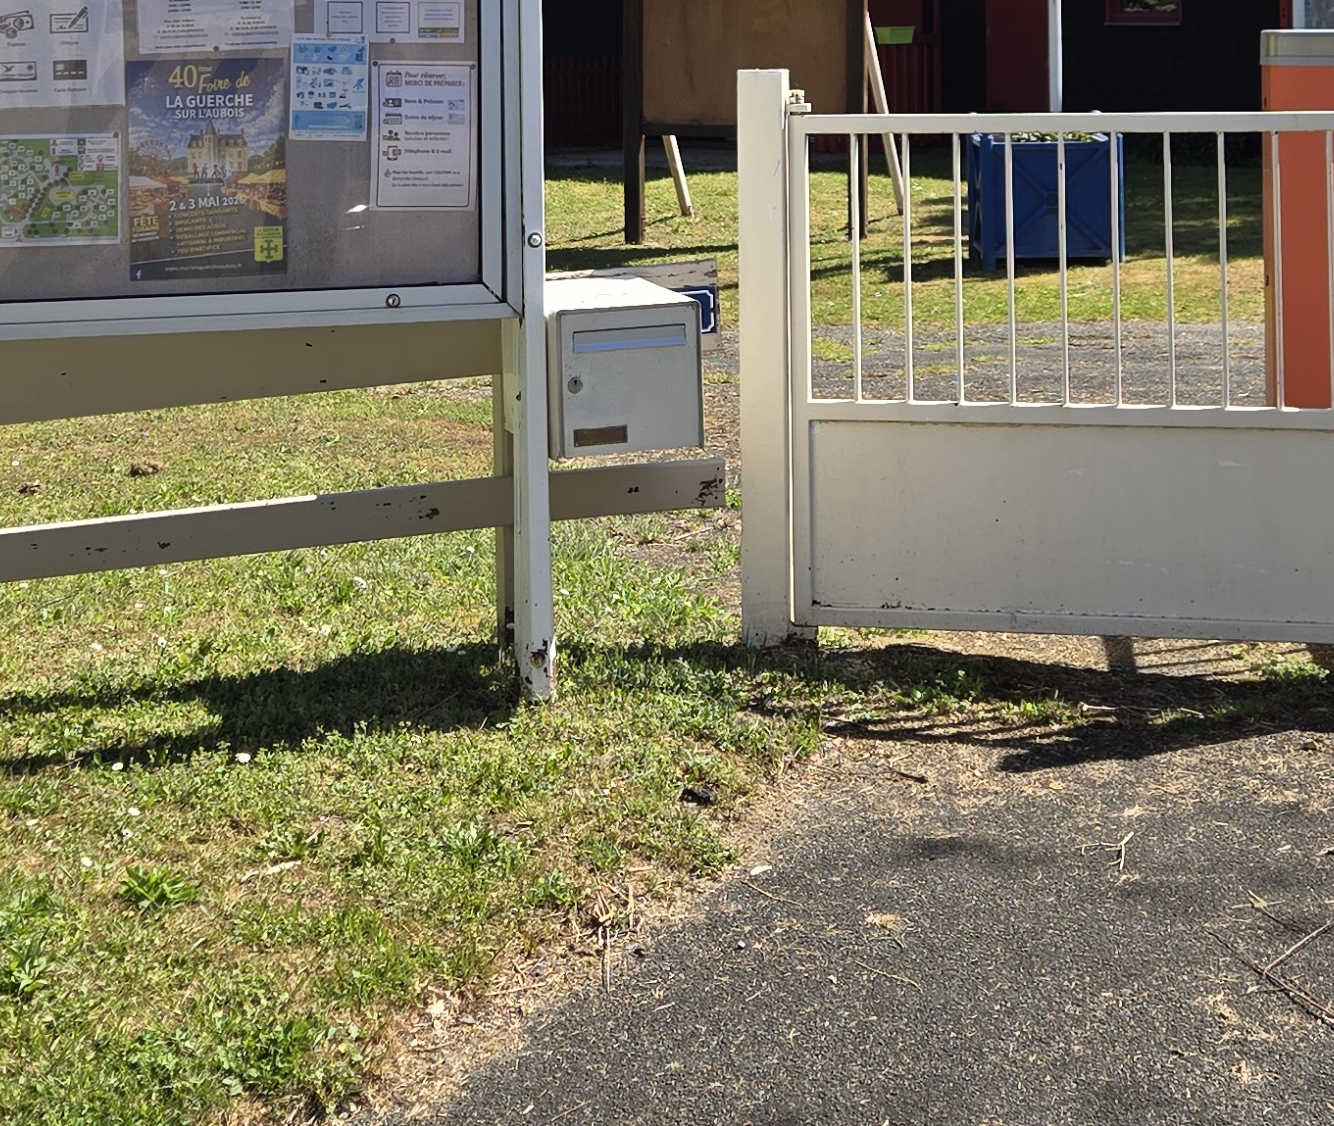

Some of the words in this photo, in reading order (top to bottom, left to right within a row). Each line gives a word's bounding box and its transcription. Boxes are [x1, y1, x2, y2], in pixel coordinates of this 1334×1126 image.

[198, 73, 231, 93] Foire
[236, 71, 251, 88] de
[166, 96, 183, 108] LA
[186, 94, 254, 107] GUERCHE
[175, 109, 196, 119] SUR
[199, 108, 245, 118] L'AUBOIS
[169, 201, 177, 211] 2
[179, 201, 187, 209] &
[188, 199, 195, 209] 3
[198, 196, 220, 208] MAI
[134, 214, 159, 227] FÊTE
